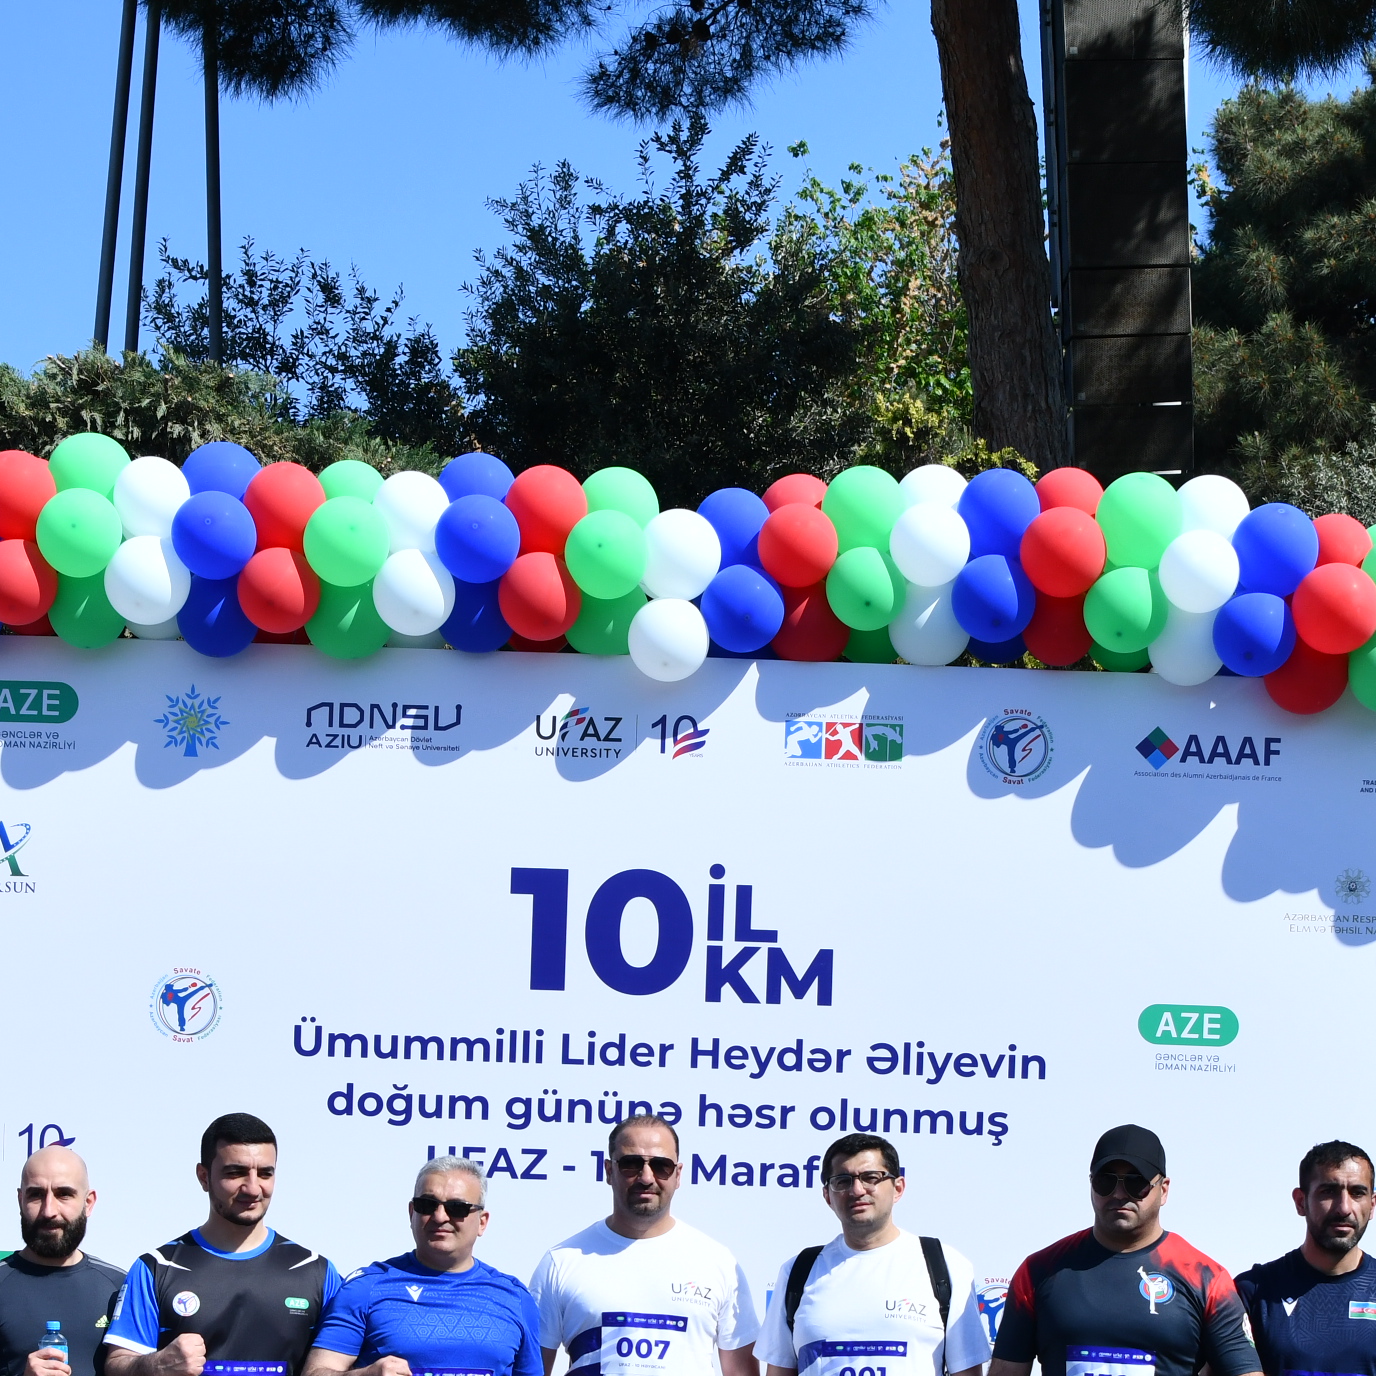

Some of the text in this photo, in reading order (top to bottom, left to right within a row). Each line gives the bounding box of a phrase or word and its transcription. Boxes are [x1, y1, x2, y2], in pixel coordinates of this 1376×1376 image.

[536, 706, 624, 744] UFAZ
[306, 733, 365, 750] AZIU
[535, 746, 622, 759] UNIVERSITY
[1179, 734, 1282, 767] AAAF
[1360, 787, 1373, 795] AND
[706, 863, 779, 944] İL
[510, 867, 695, 996] 10
[704, 944, 835, 1007] KM
[1155, 1011, 1222, 1039] AZE
[293, 1016, 1048, 1086] Ümummilli Lider Heydər Əliyevin
[327, 1082, 490, 1130] doğum
[698, 1094, 796, 1130] həsr
[810, 1098, 1010, 1146] olunmuş
[288, 1298, 307, 1308] AZE
[671, 1296, 711, 1308] UNIVERSITY
[884, 1313, 927, 1323] UNIVERSITY
[616, 1336, 671, 1360] 007
